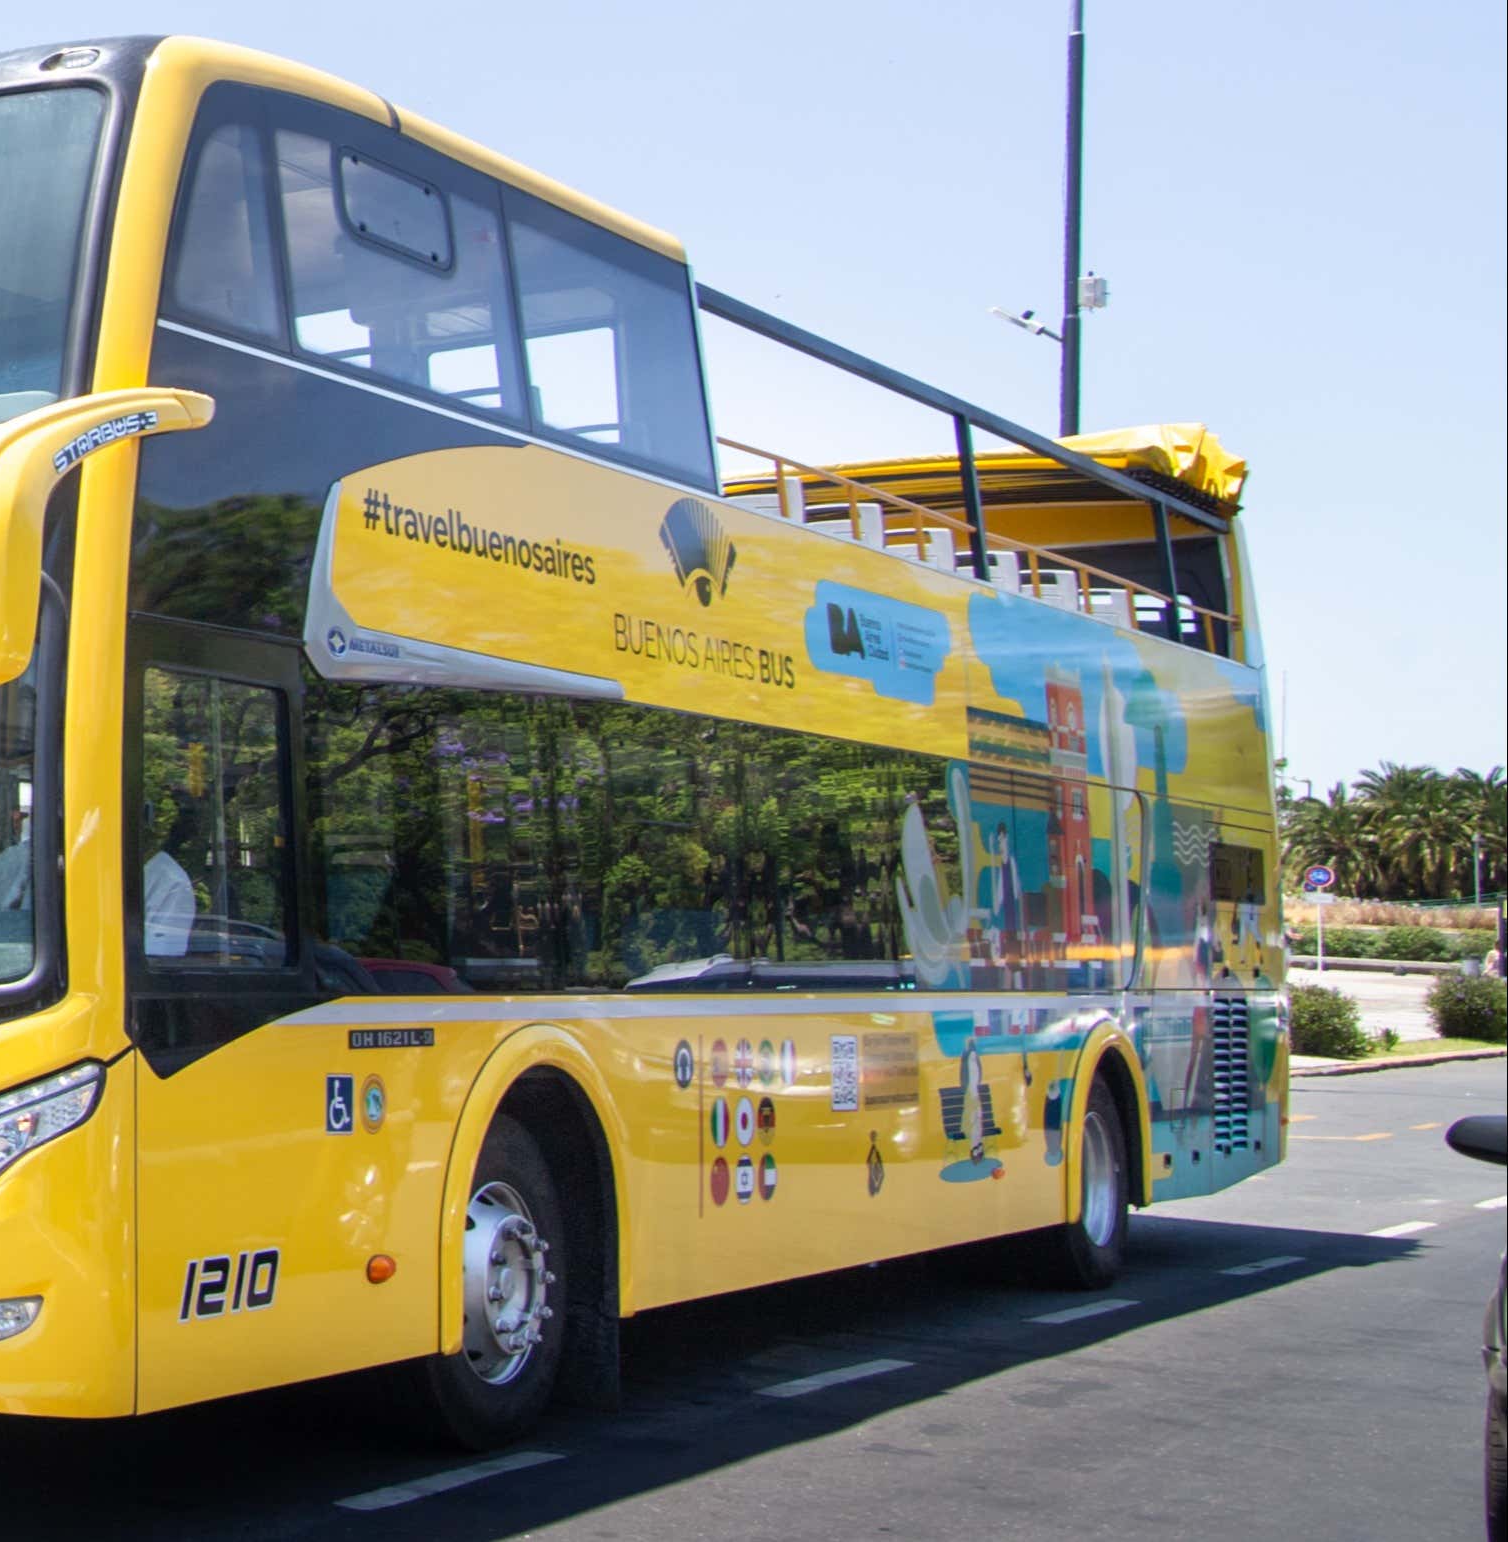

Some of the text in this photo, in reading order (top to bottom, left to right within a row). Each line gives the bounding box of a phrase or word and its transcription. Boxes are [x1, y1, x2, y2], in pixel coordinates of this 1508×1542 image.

[363, 488, 596, 585] #travelbuenosaires
[614, 613, 796, 689] BUENOS AIRES BUS
[177, 1246, 281, 1324] 1210
